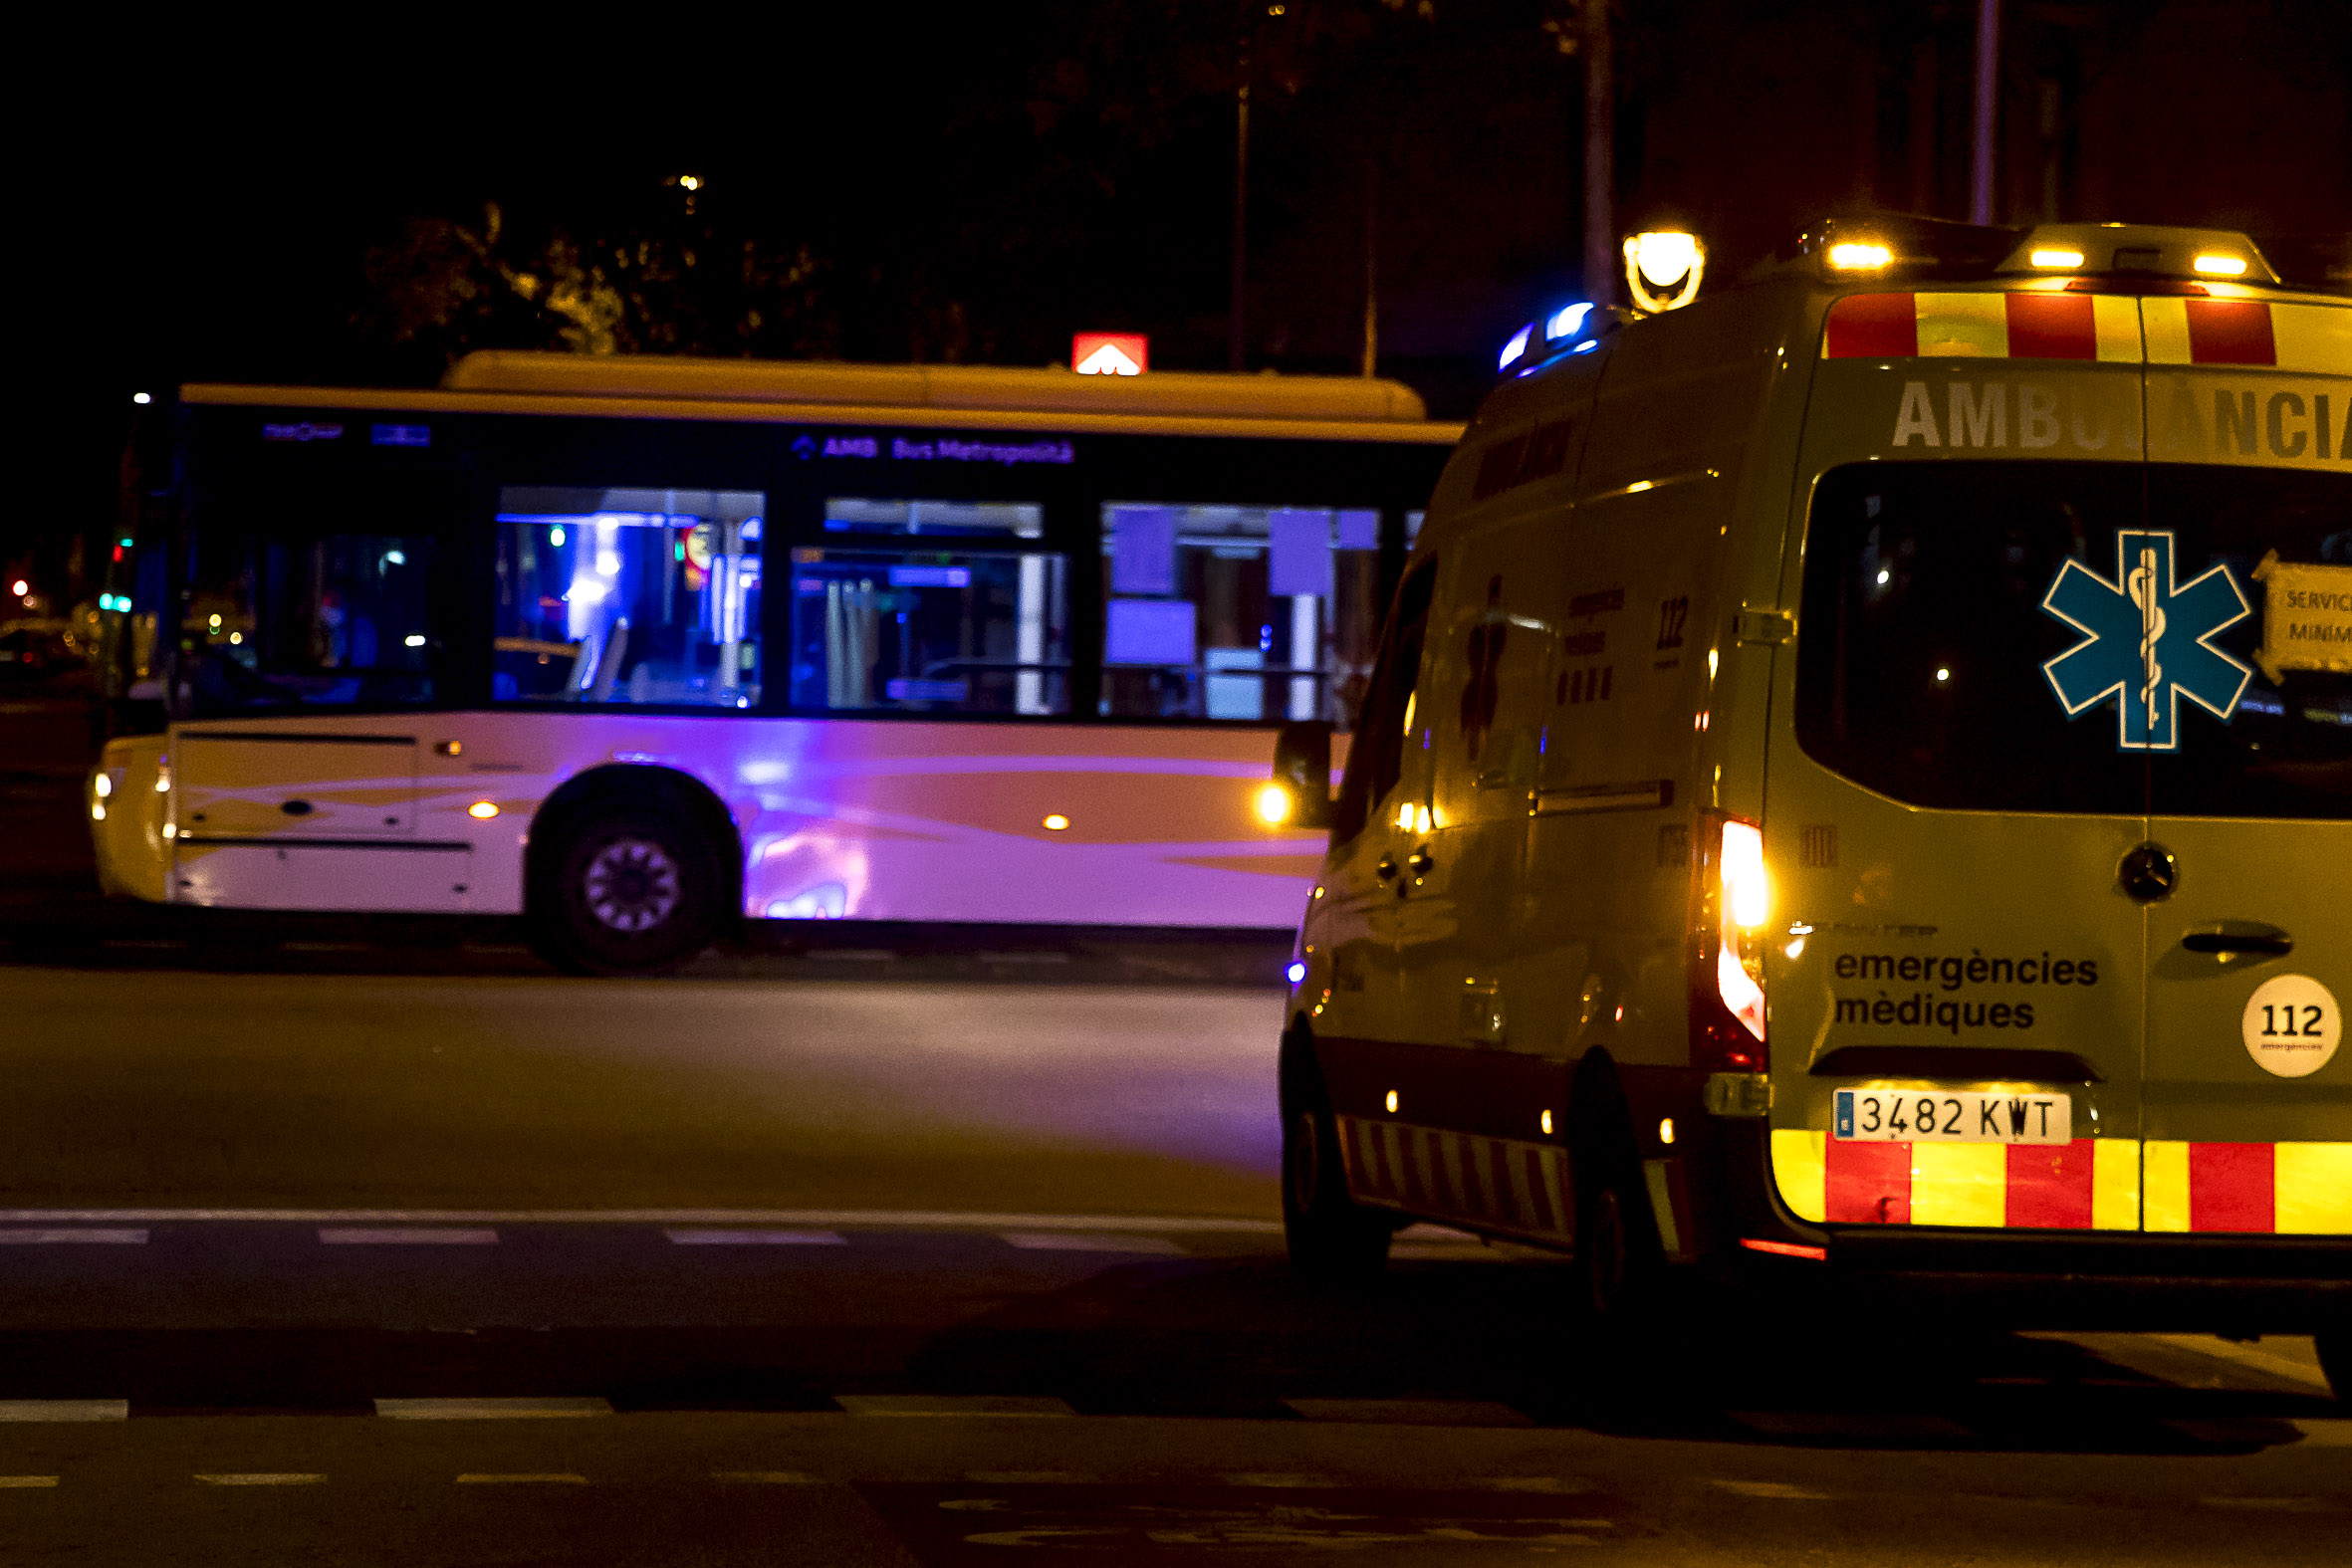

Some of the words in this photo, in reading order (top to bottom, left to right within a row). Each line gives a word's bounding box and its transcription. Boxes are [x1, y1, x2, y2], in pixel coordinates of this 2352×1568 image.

[823, 435, 878, 459] AMB
[891, 436, 934, 460] Bus
[2286, 589, 2352, 612] SERVIC
[1656, 595, 1689, 650] 112
[1834, 948, 2099, 992] emergències
[1835, 991, 2035, 1035] mèdiques
[2261, 1004, 2323, 1037] 112
[1861, 1096, 1963, 1135] 3482
[1980, 1098, 2054, 1137] KWT
